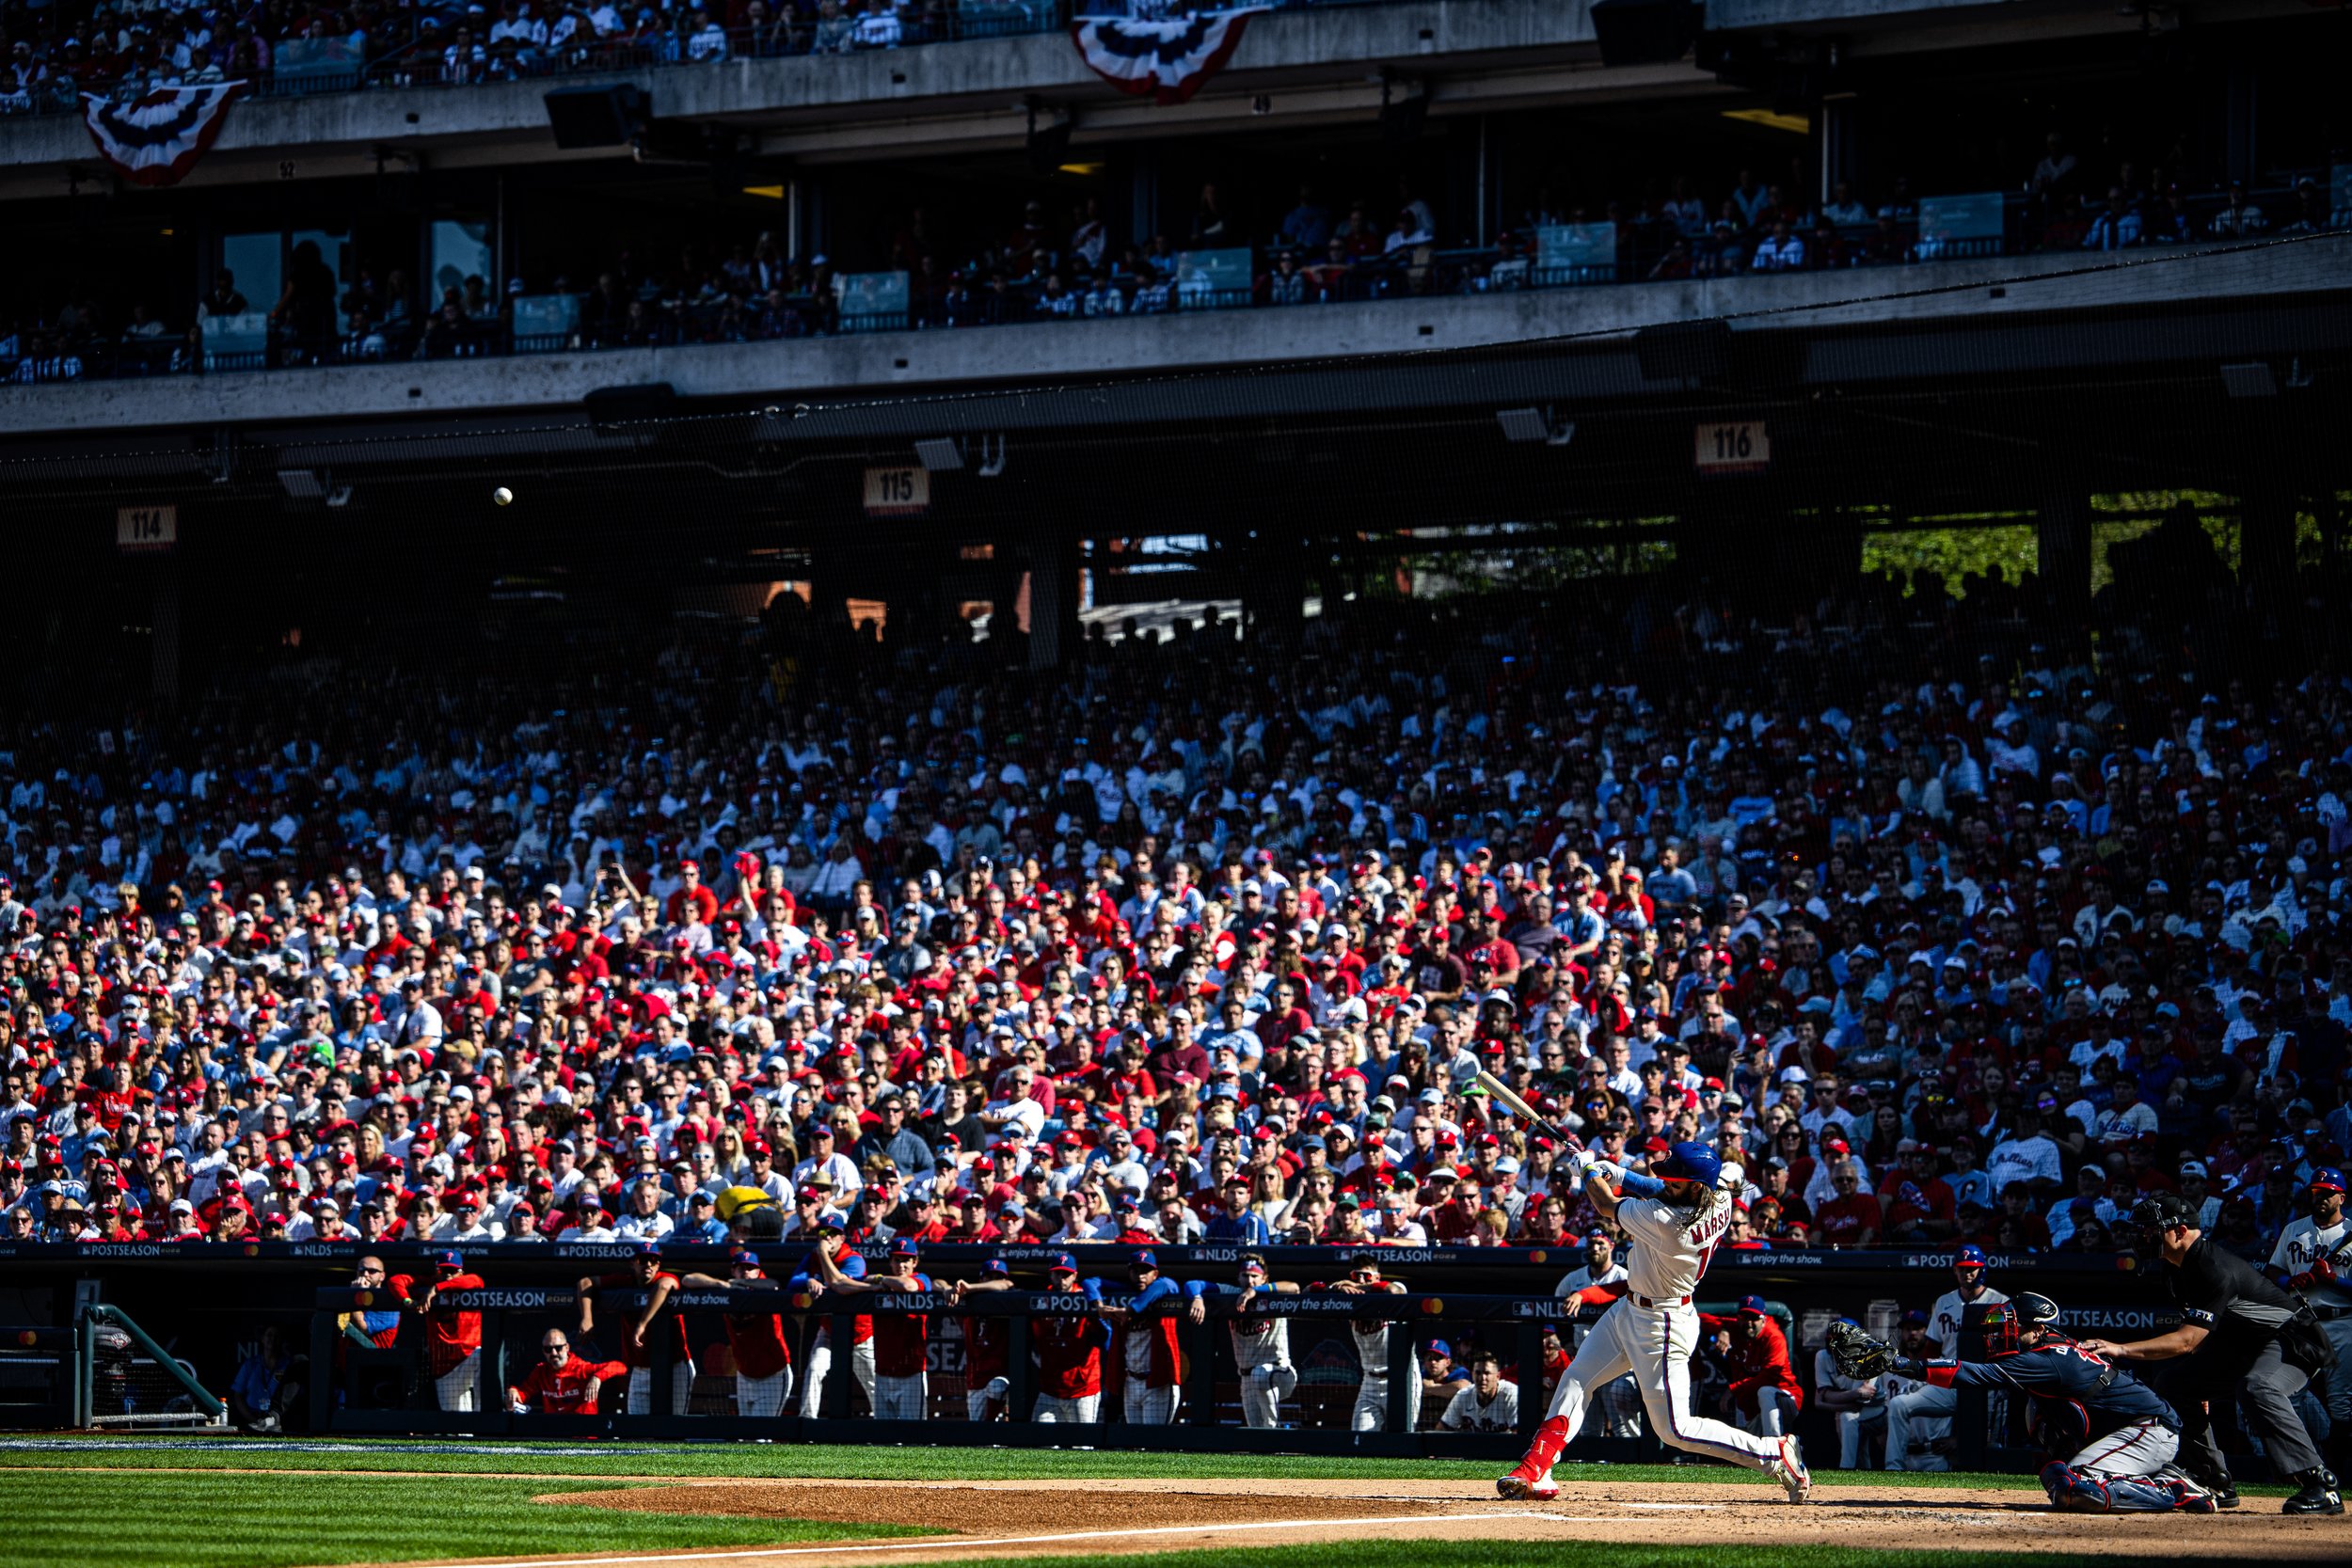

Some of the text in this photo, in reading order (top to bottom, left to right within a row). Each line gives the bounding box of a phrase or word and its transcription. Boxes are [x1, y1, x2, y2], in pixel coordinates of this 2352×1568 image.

[1714, 426, 1751, 458] 116
[881, 471, 913, 500] 115
[132, 511, 160, 538] 114
[1690, 1208, 1730, 1245] MARSH
[91, 1244, 160, 1256] POSTSEASON
[304, 1245, 332, 1256] NLDS
[569, 1246, 634, 1258] POSTSEASO
[1008, 1249, 1029, 1259] enjoy
[1206, 1248, 1237, 1261] NLDS
[1753, 1253, 1821, 1266] enjoy the show.
[452, 1291, 545, 1307] POSTSEASON
[682, 1292, 699, 1305] the
[896, 1294, 934, 1309] NLDS
[1269, 1299, 1353, 1314] enjoy the show.
[1534, 1302, 1564, 1317] NLD
[2059, 1310, 2154, 1328] STSEASON
[2195, 1308, 2214, 1323] FTX
